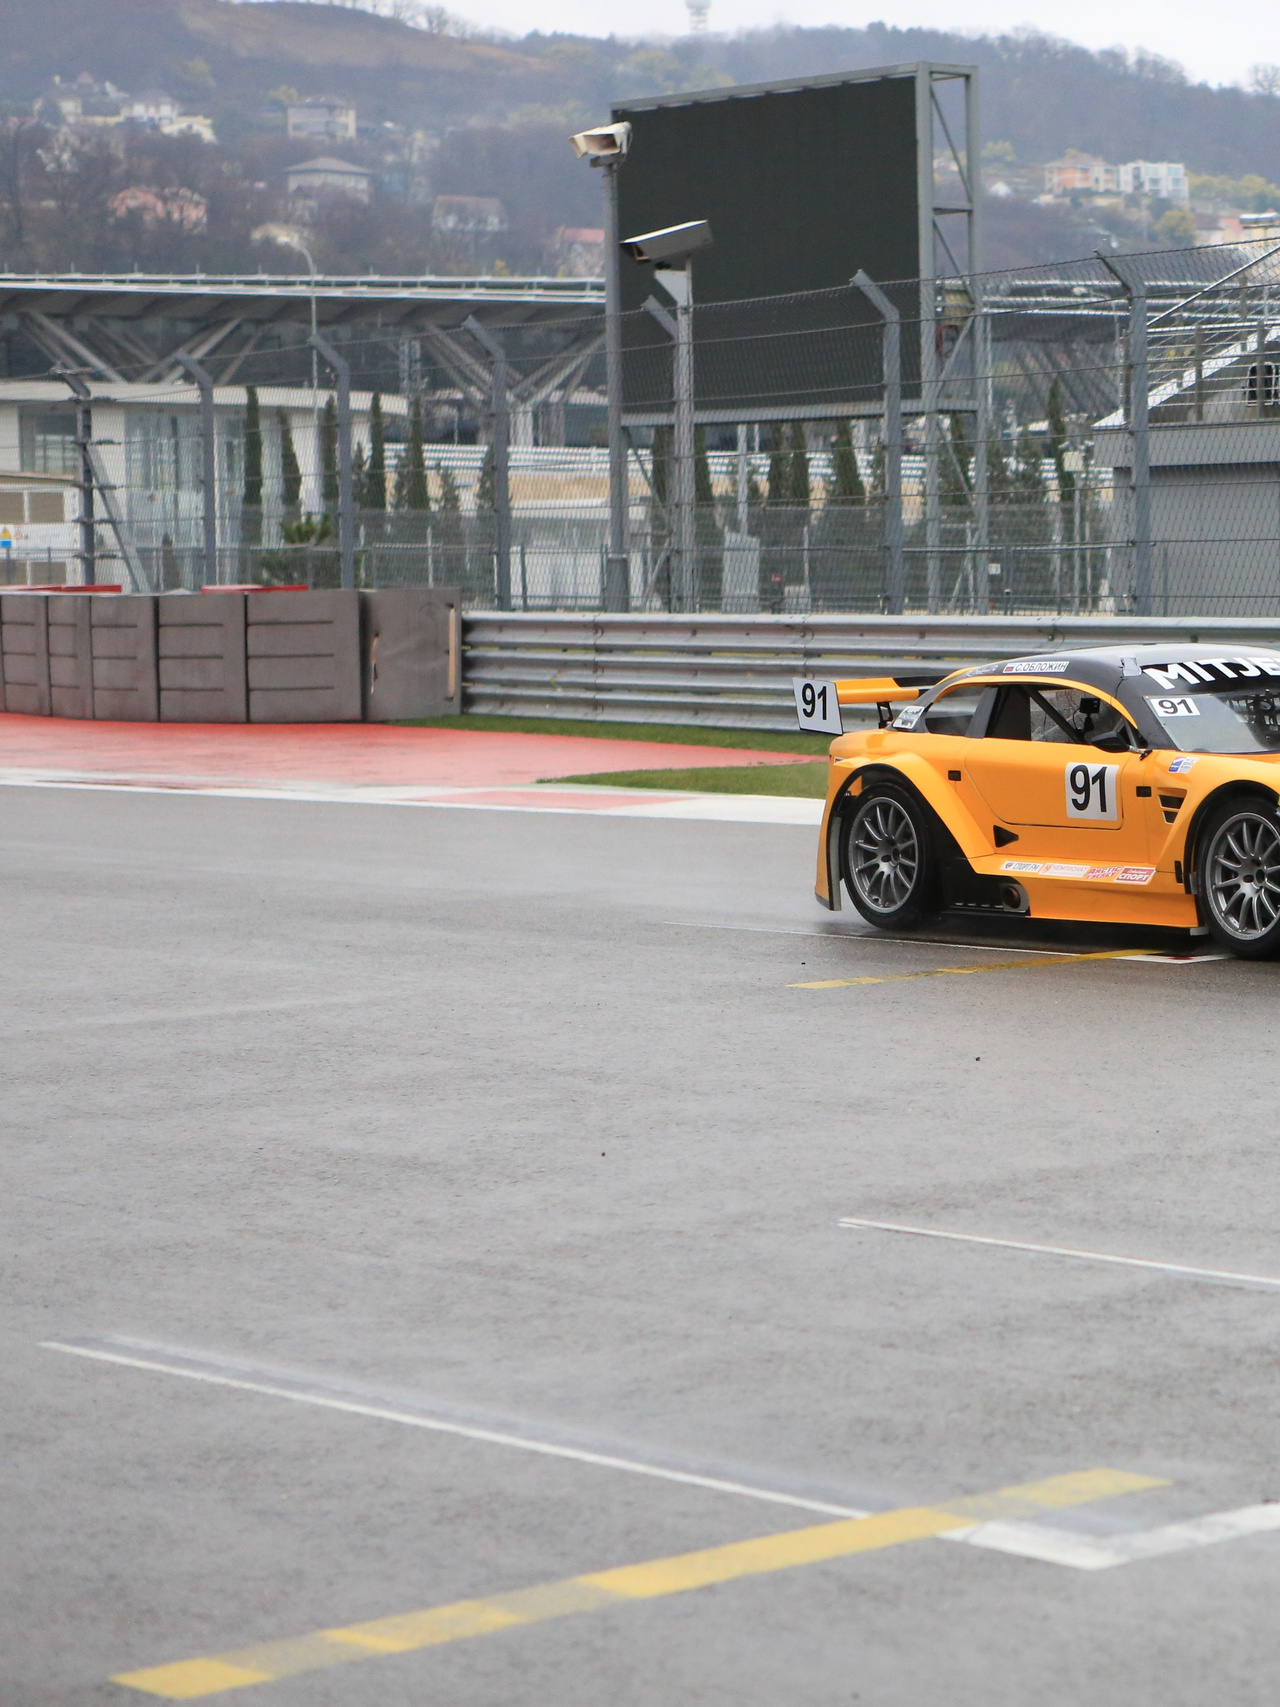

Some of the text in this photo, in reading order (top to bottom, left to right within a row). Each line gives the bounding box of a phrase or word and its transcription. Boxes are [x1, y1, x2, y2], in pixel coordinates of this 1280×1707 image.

[1014, 661, 1068, 672] С.ОБЛОЖИН
[801, 682, 828, 721] 91
[1158, 698, 1194, 715] 91
[1069, 764, 1108, 813] 91
[1118, 873, 1150, 881] СПОРТ
